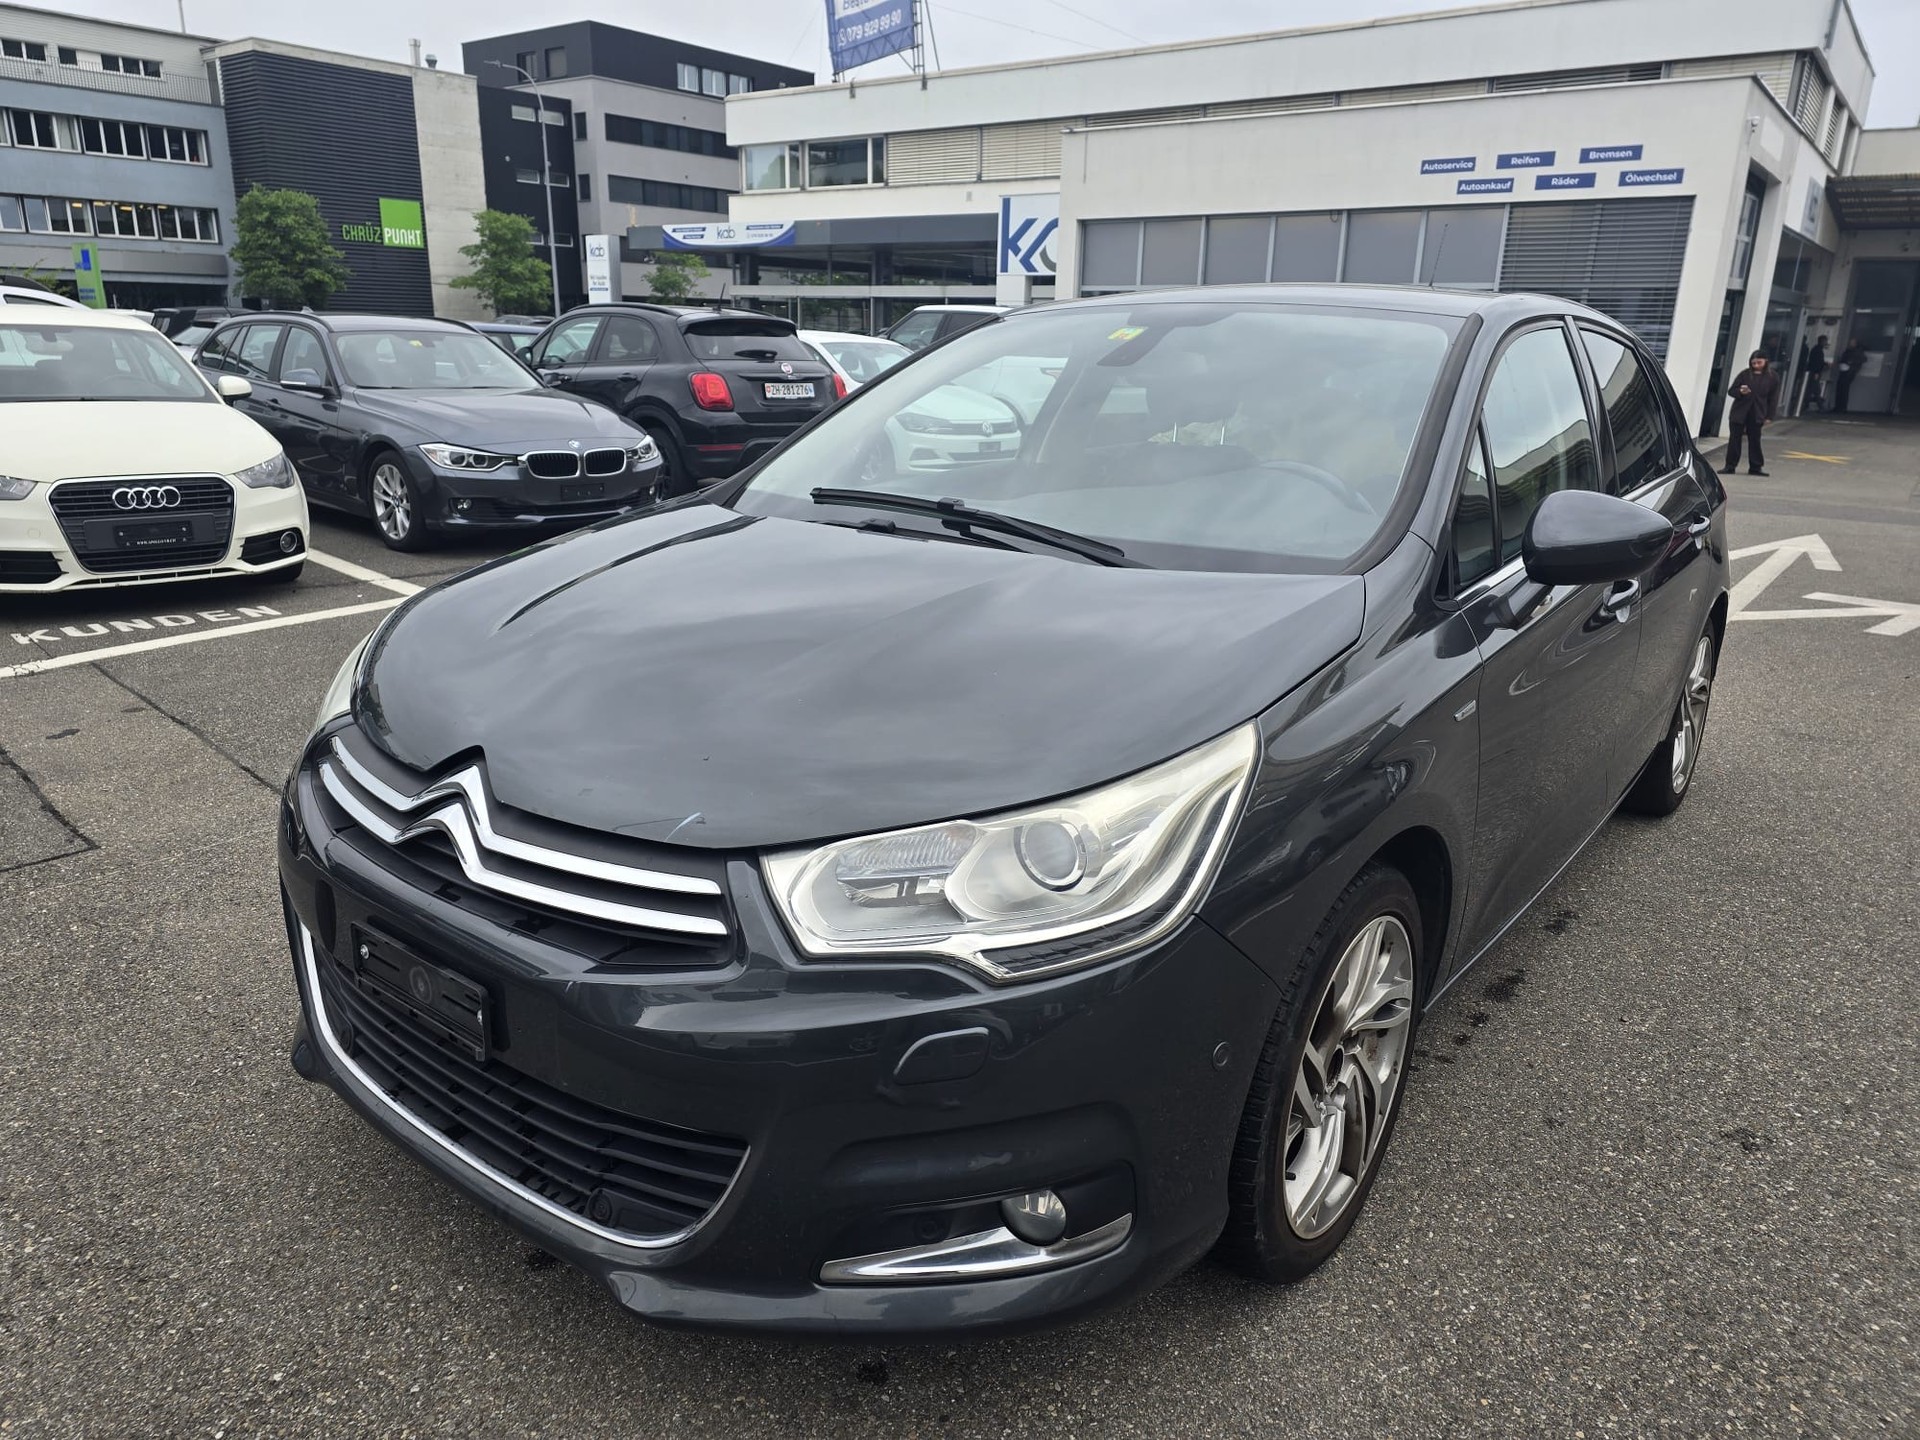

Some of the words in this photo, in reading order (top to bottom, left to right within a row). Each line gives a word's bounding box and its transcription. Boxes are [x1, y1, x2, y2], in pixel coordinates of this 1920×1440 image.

[846, 24, 863, 41] 079
[1589, 149, 1633, 160] Bremsen
[1423, 160, 1474, 171] Autoservice
[1511, 156, 1541, 165] Reifen
[1551, 177, 1580, 186] Räder
[1625, 172, 1678, 183] Ölwechsel
[1459, 181, 1512, 191] Autoankauf
[342, 221, 382, 243] CHRÜZ
[383, 227, 421, 246] PUNKT
[10, 605, 282, 645] KUNDEN
